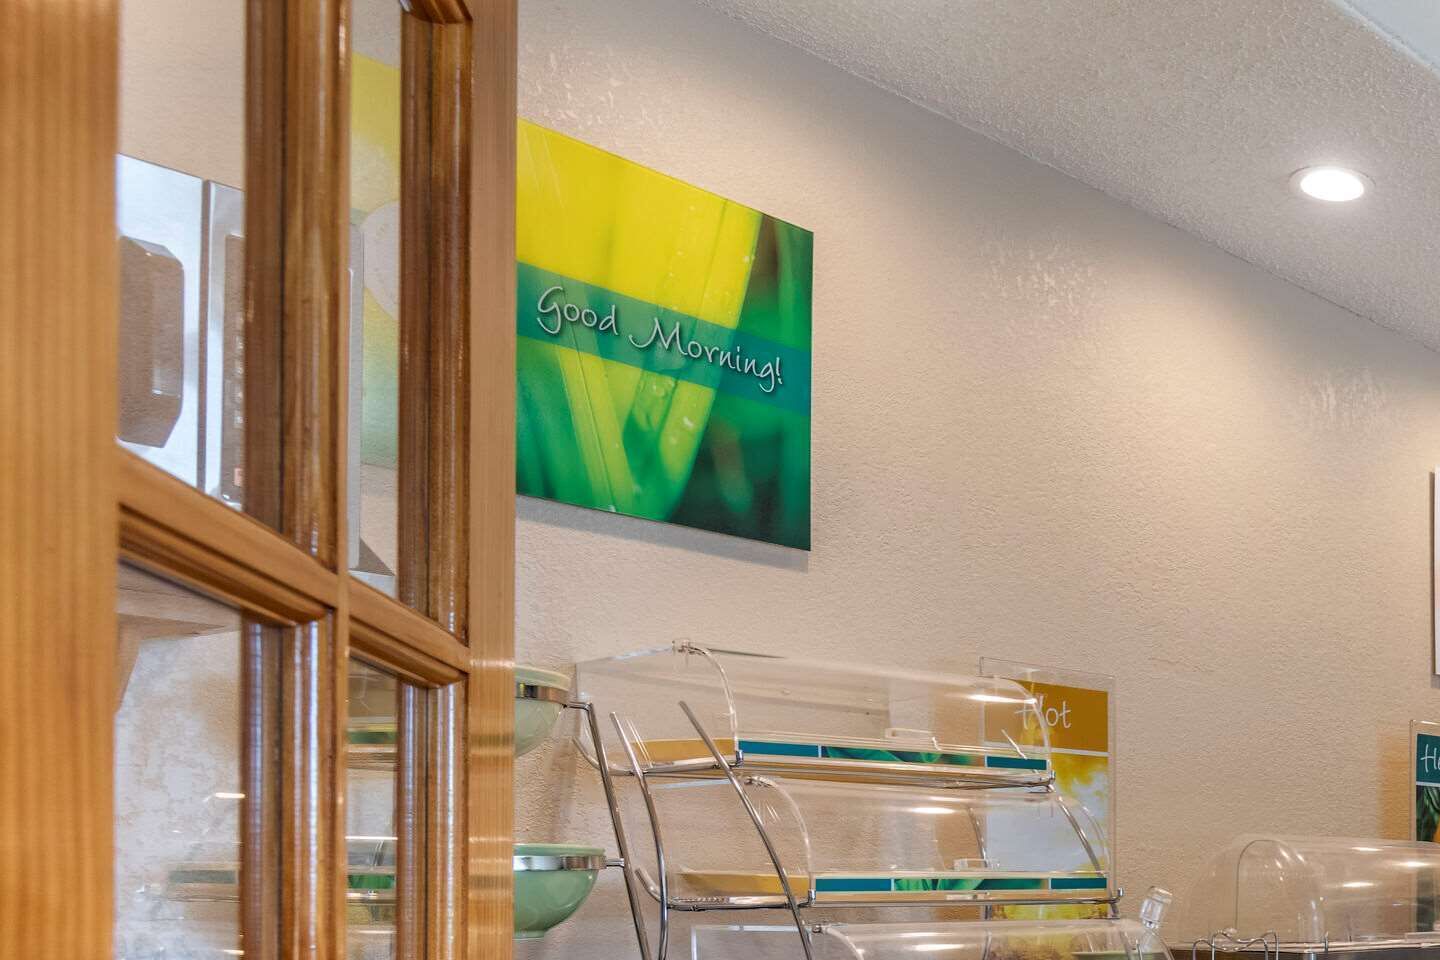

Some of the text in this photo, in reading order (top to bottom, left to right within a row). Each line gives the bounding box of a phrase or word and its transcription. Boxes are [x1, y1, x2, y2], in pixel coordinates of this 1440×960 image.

[537, 286, 783, 393] Good Morning!
[1014, 694, 1072, 729] Hot
